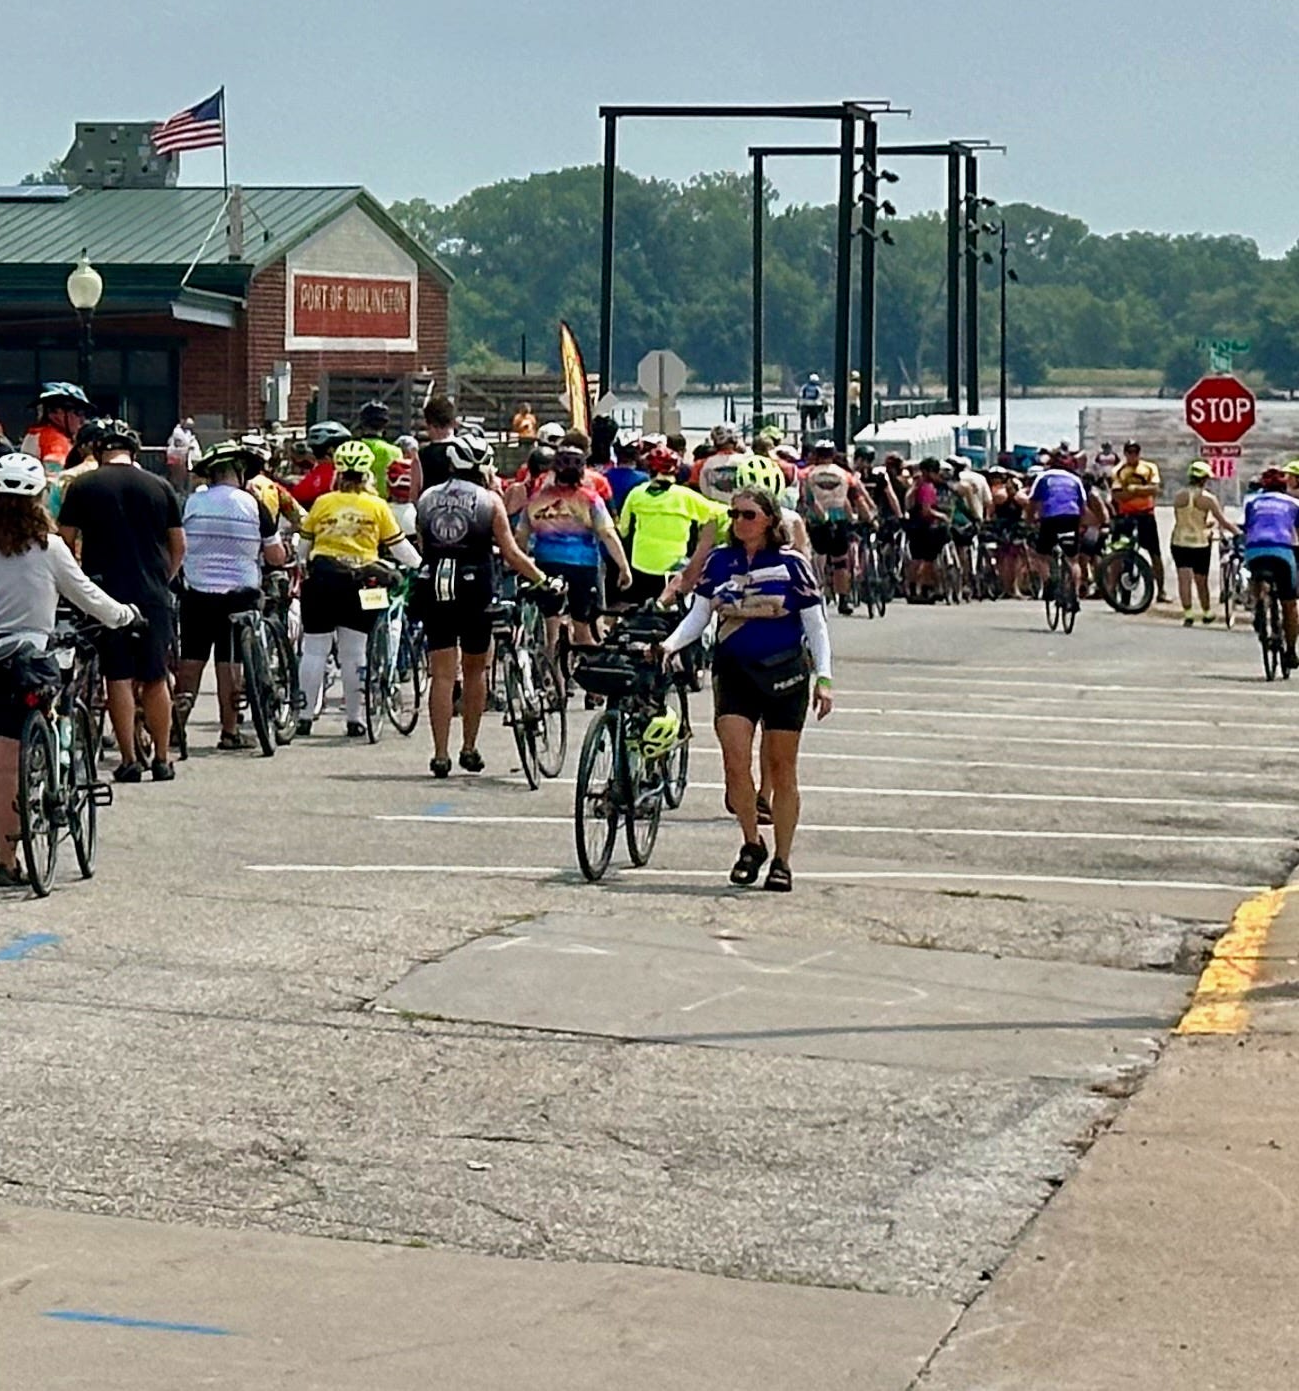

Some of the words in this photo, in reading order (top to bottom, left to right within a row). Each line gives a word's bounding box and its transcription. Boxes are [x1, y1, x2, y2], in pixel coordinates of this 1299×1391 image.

[300, 284, 328, 311] PORT
[330, 285, 344, 311] OF
[347, 287, 407, 314] BURLINGTON
[1191, 398, 1251, 423] STOP
